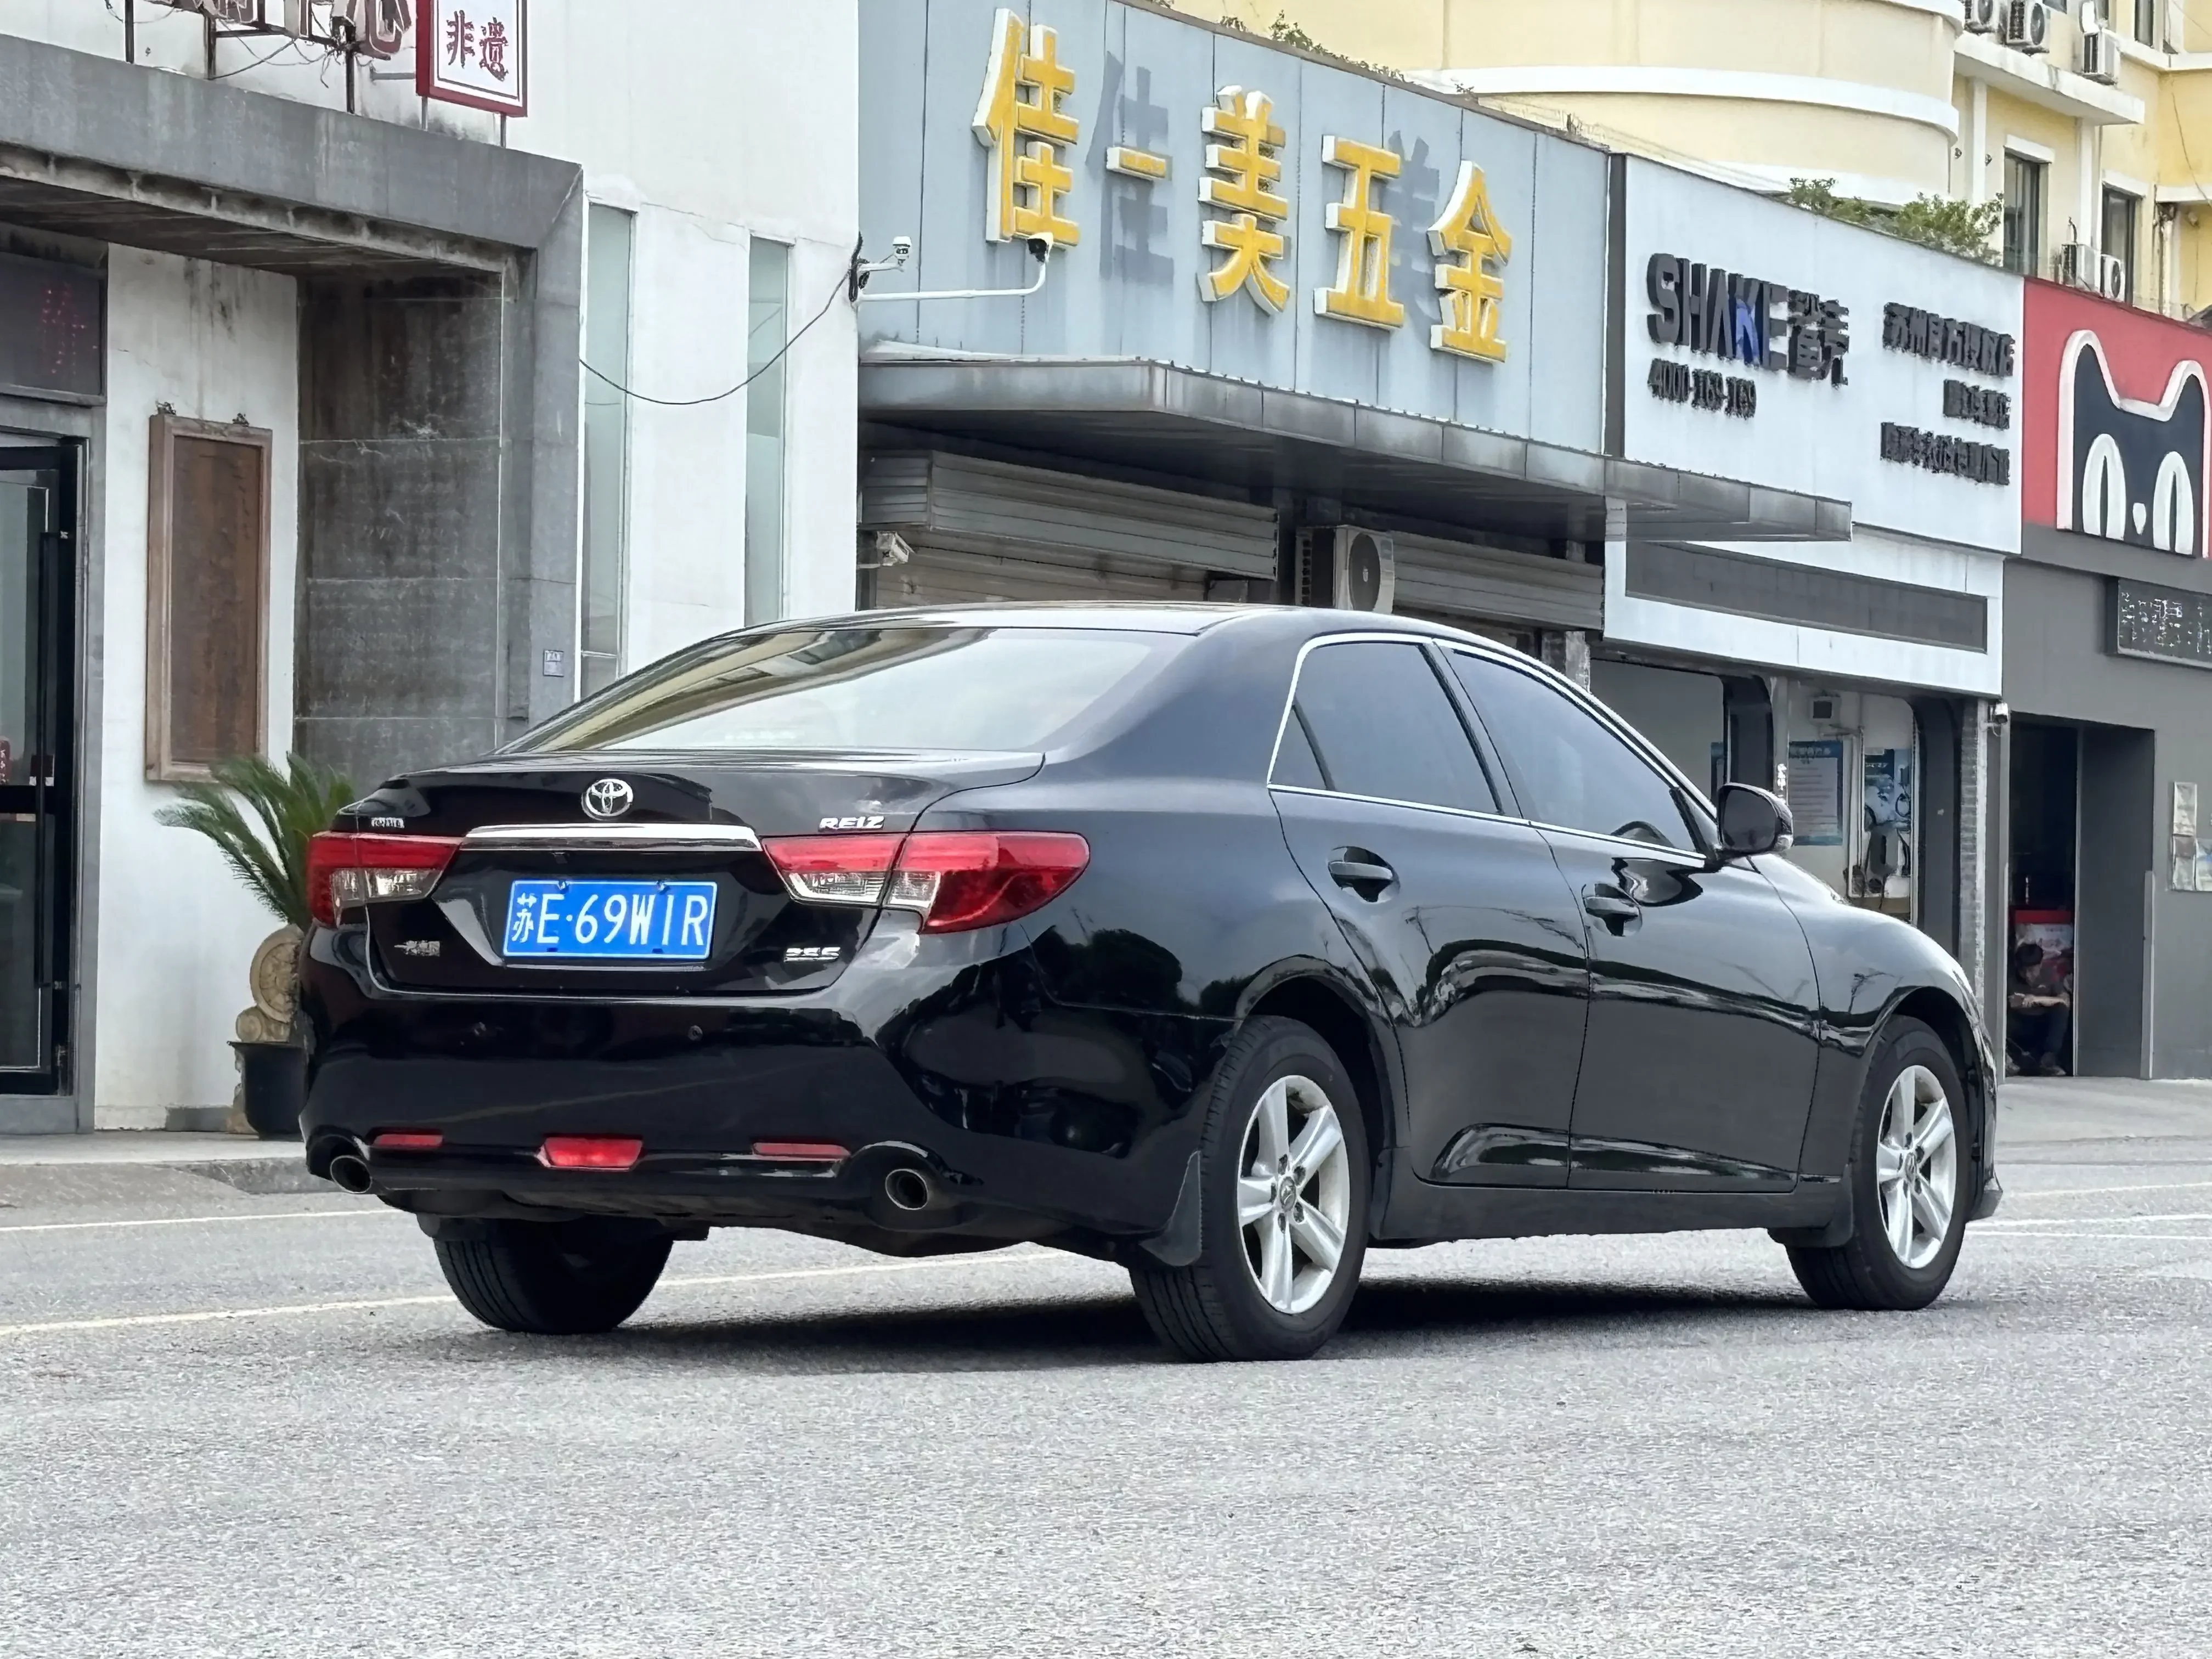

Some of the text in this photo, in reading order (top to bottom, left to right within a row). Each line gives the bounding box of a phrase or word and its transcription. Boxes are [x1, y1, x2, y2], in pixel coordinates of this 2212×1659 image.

[447, 10, 509, 82] 非遗
[1647, 253, 1787, 371] SHAKE
[819, 816, 884, 830] REIZ
